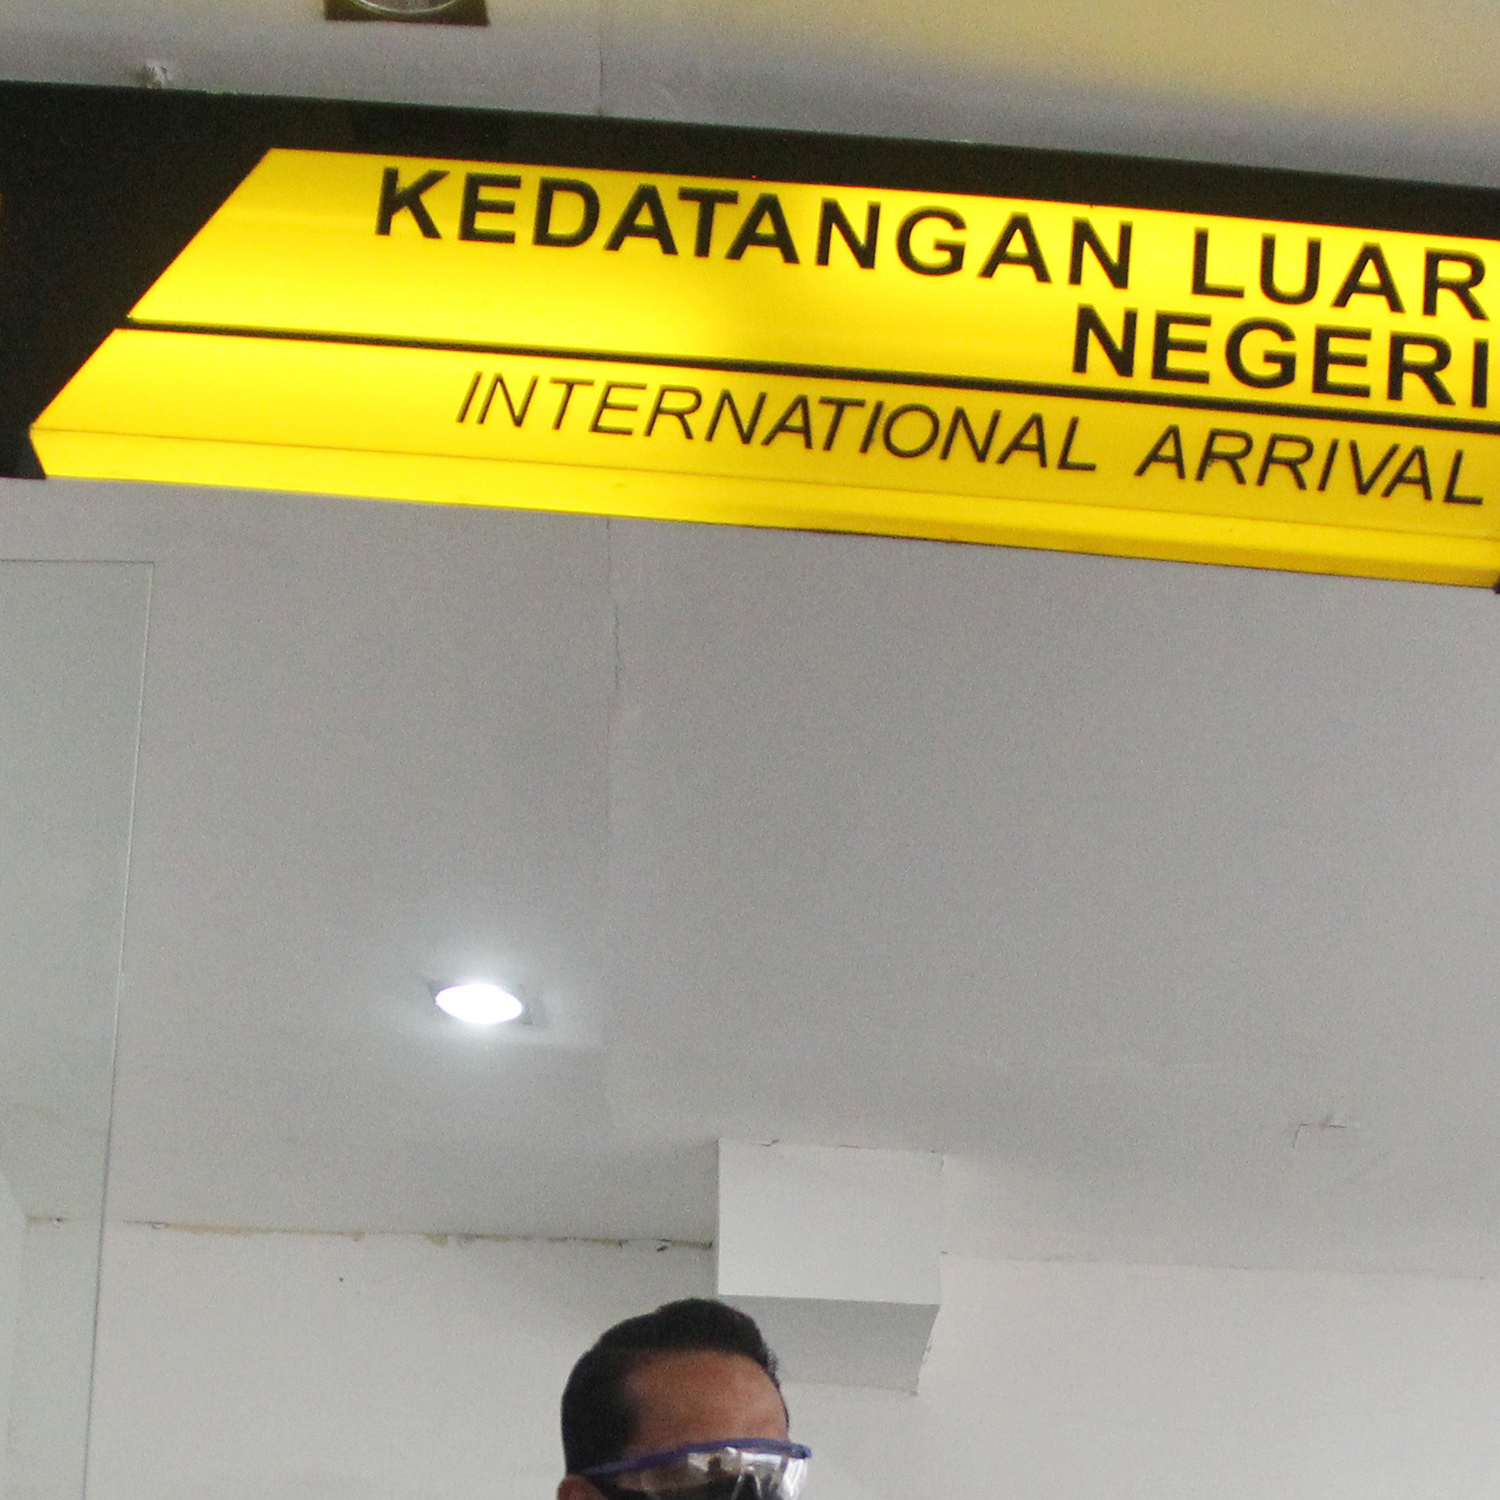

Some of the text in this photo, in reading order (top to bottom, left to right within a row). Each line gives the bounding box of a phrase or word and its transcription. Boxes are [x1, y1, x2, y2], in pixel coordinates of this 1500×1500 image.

[374, 166, 1491, 321] KEDATANGAN LUAR
[1072, 303, 1491, 409] NEGERI
[455, 370, 1485, 506] INTERNATIONAL ARRIVAL
